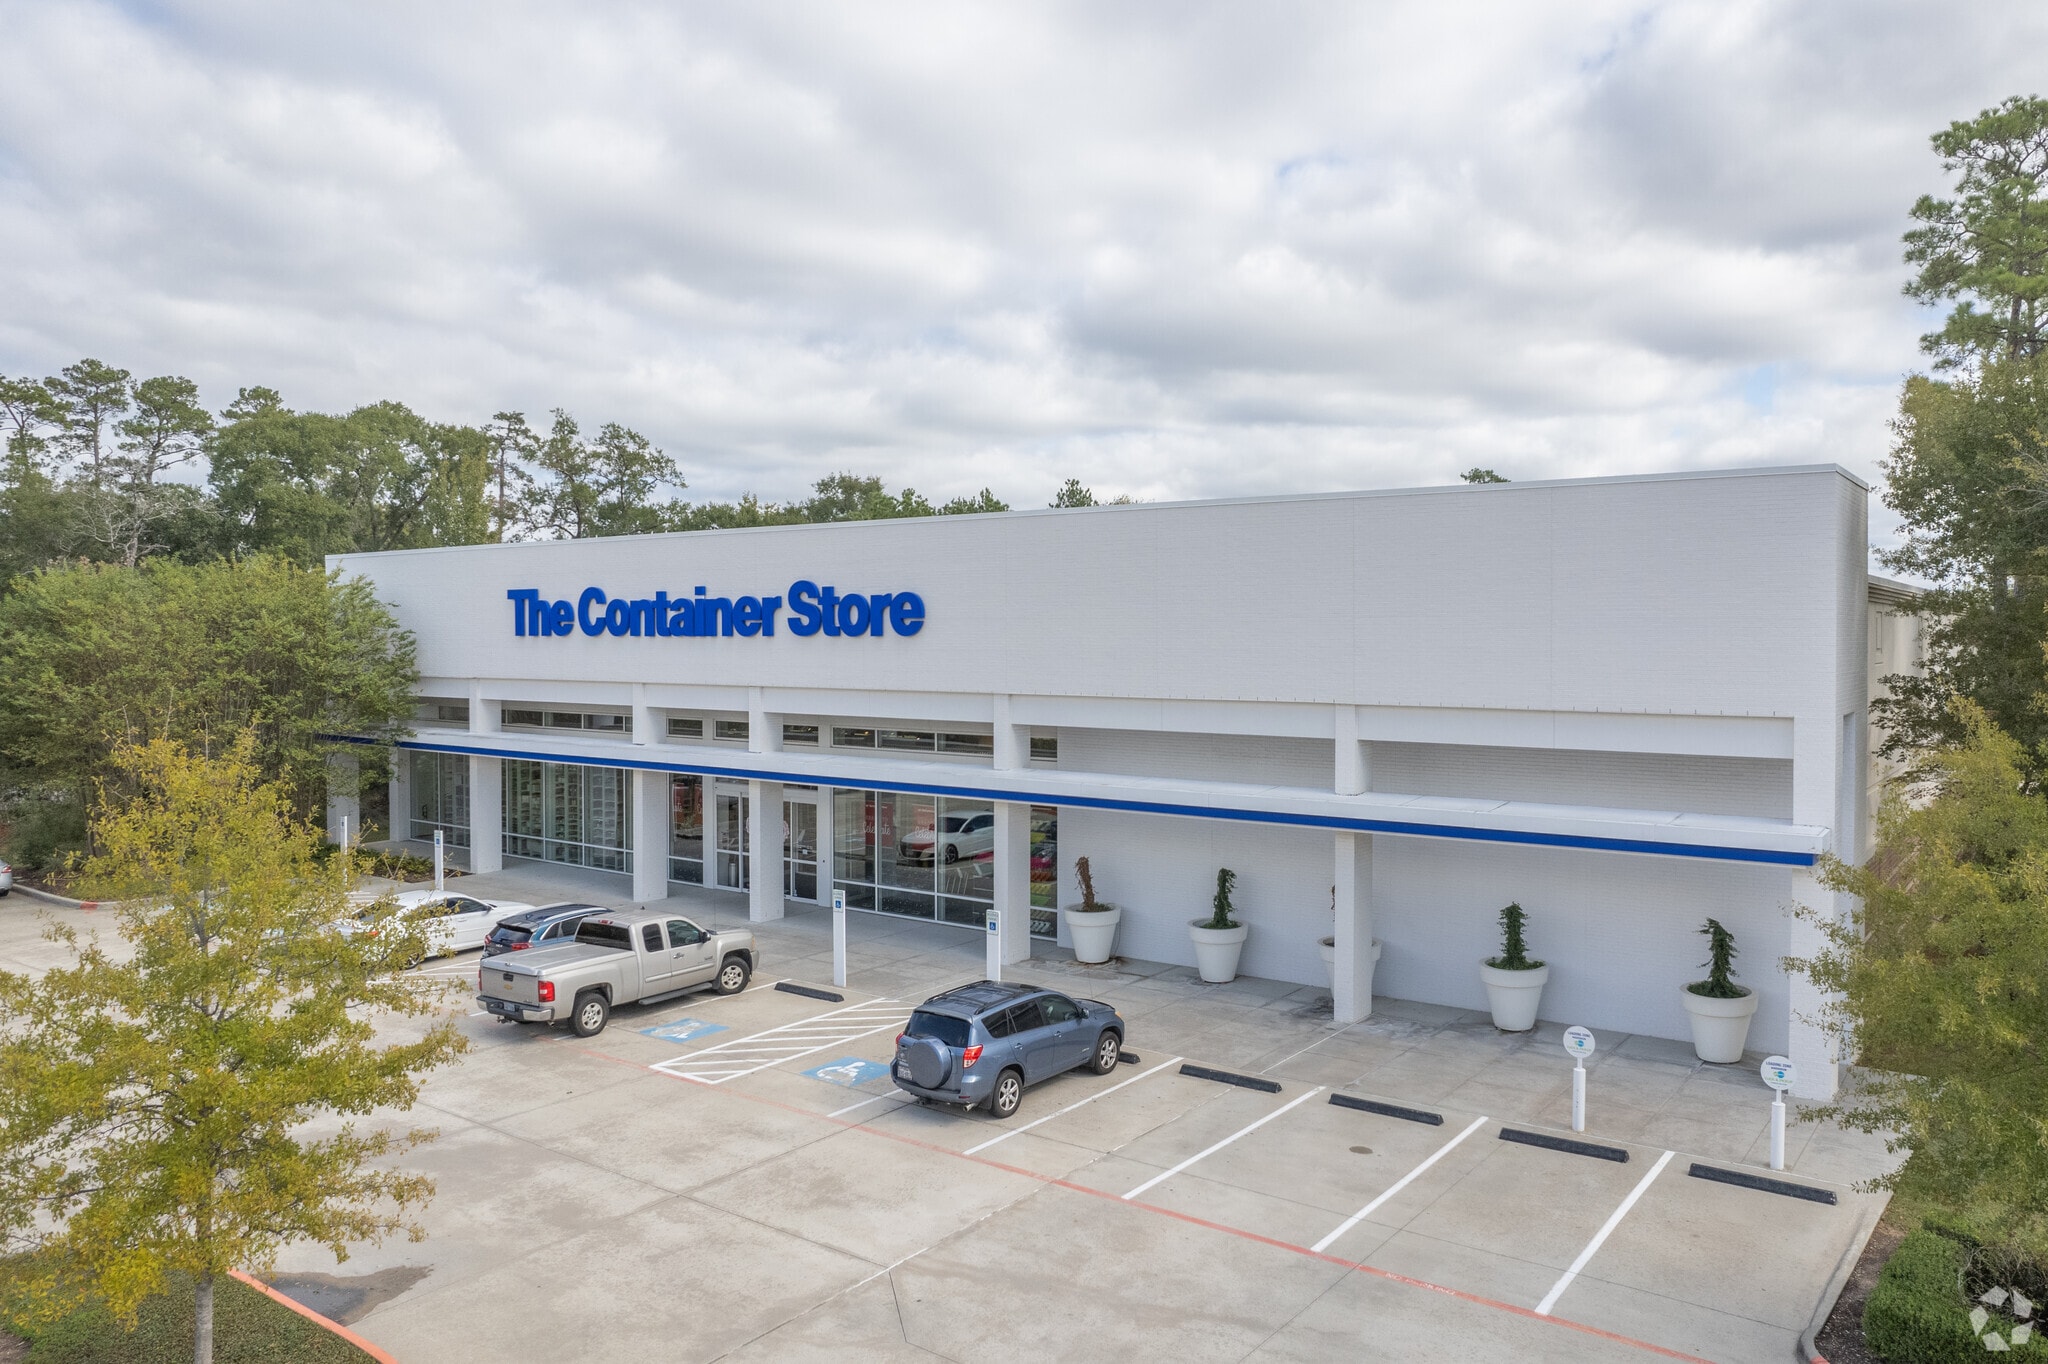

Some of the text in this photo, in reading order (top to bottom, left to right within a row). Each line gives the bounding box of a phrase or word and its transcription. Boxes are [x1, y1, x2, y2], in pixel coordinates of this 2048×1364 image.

[507, 580, 925, 637] The Container Store
